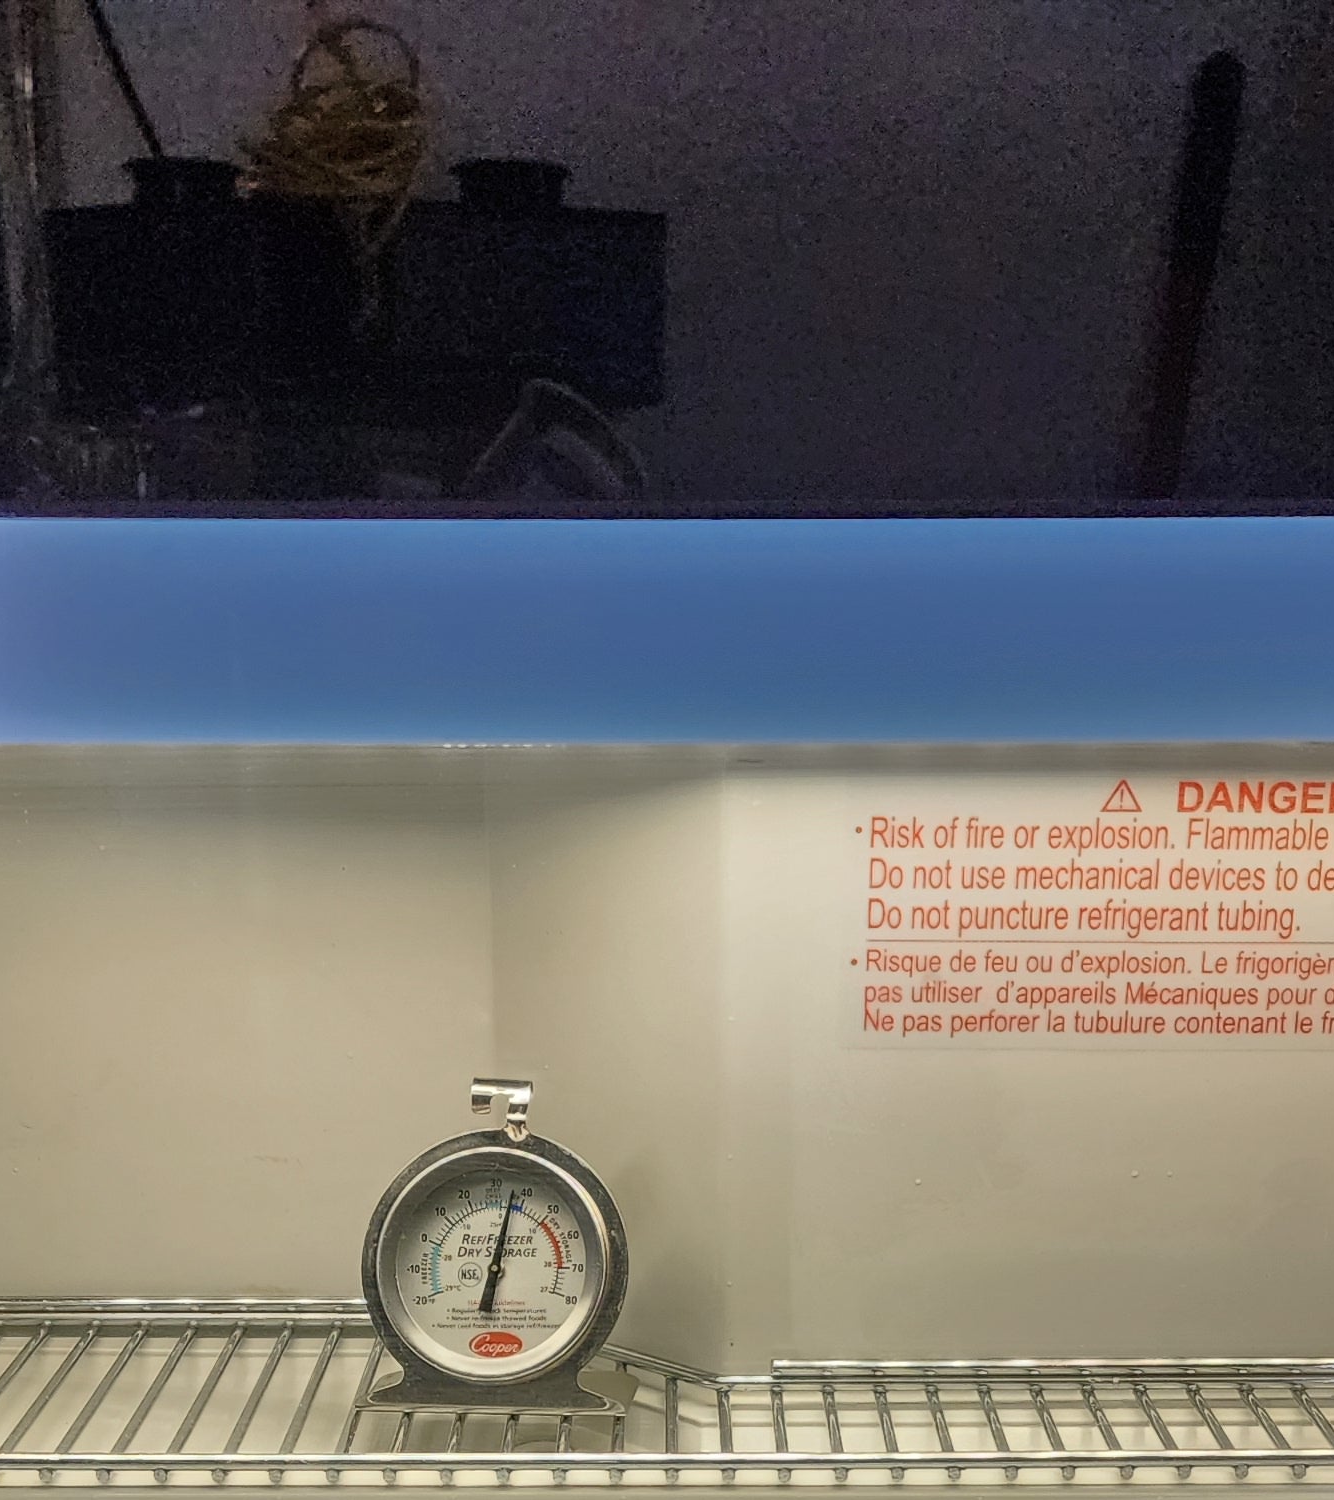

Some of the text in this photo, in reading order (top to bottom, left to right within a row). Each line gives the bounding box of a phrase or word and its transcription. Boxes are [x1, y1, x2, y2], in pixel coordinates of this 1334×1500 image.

[870, 817, 924, 848] Risk
[934, 817, 958, 849] of
[966, 817, 1005, 849] fire
[1014, 825, 1039, 849] or
[1048, 818, 1175, 856] explosion.
[1187, 818, 1329, 851] Flammable
[869, 858, 903, 889] Do
[913, 860, 952, 889] not
[961, 865, 1005, 889] use
[1015, 858, 1159, 890] mechanical
[1169, 859, 1265, 891] devices
[1275, 861, 1298, 891] to
[867, 898, 1301, 939] Do not puncture refrigerant tubing.
[866, 950, 941, 977] Risque
[949, 950, 976, 972] de
[984, 950, 1017, 973] feu
[1026, 955, 1053, 973] ou
[1201, 951, 1228, 974] Le
[865, 986, 903, 1007] pas
[911, 981, 982, 1003] utiliser
[1125, 982, 1259, 1010] Mécaniques
[1266, 987, 1317, 1009] pour
[864, 1009, 894, 1031] Ne
[903, 1013, 942, 1037] pas
[950, 1009, 1039, 1038] perforer
[1047, 1009, 1065, 1032] la
[1075, 1010, 1165, 1033] tubulure
[1174, 1011, 1286, 1034] contenant
[1294, 1012, 1313, 1034] le
[458, 1190, 471, 1199] 20
[521, 1188, 533, 1197] 40
[435, 1207, 446, 1216] 10
[547, 1205, 559, 1214] 50
[421, 1233, 427, 1242] 0
[462, 1234, 533, 1245] REF/FREZER
[567, 1230, 579, 1239] 60
[457, 1246, 537, 1257] DRY SORAGE
[572, 1264, 583, 1272] 70
[565, 1296, 577, 1304] 80
[471, 1334, 519, 1356] Cooper
